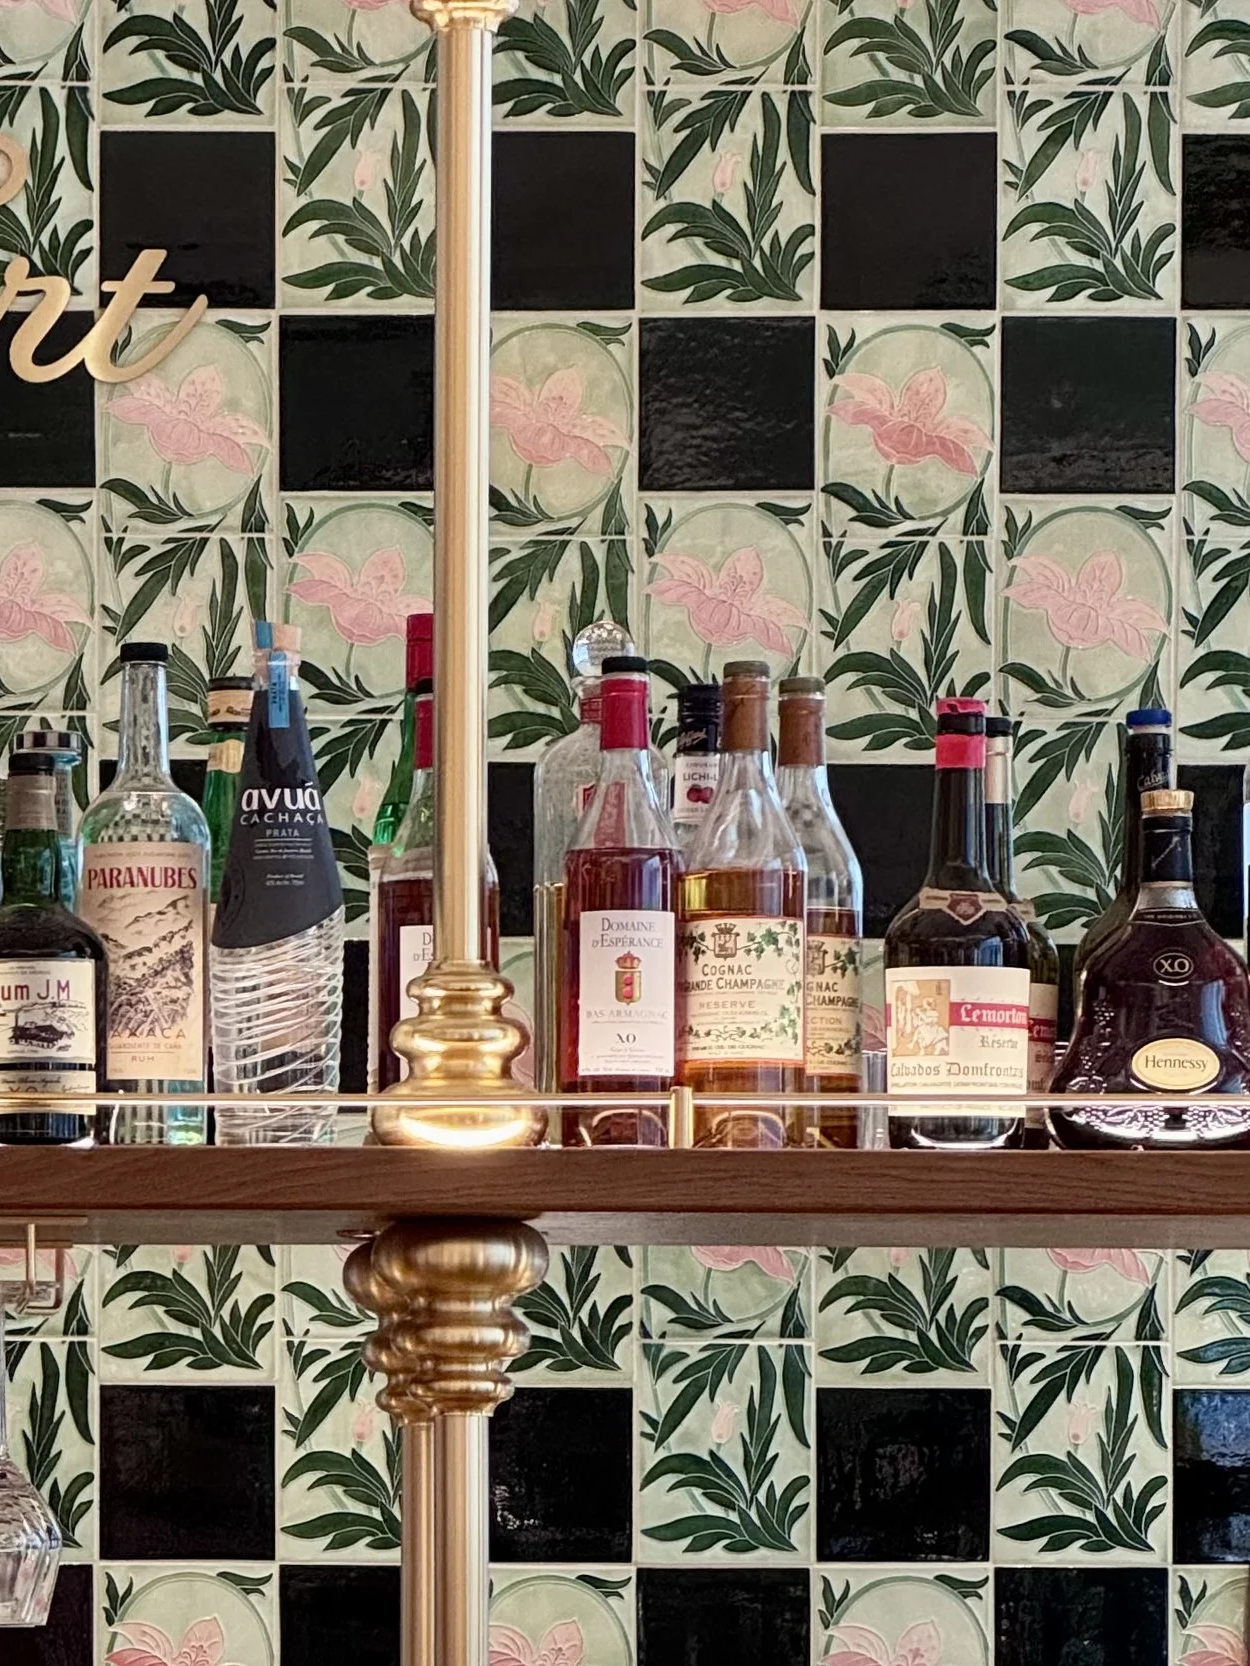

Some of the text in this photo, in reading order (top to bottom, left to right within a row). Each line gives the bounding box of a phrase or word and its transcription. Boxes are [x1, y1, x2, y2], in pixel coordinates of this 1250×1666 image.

[683, 772, 718, 781] LICHI-L
[241, 781, 321, 812] avuá
[239, 812, 324, 826] CACHAÇA
[265, 828, 300, 838] PRATA
[87, 866, 197, 890] PARANUBES
[601, 917, 656, 932] DOMAINE
[702, 963, 752, 976] COGNAC
[36, 979, 70, 1001] J.M
[684, 977, 785, 992] RANDE CHAMPAGNE
[699, 1000, 756, 1009] RESERVE
[810, 1016, 842, 1025] CTION
[110, 1028, 187, 1039] AXACA
[616, 1033, 636, 1043] XO
[1144, 1055, 1208, 1070] Hennessy
